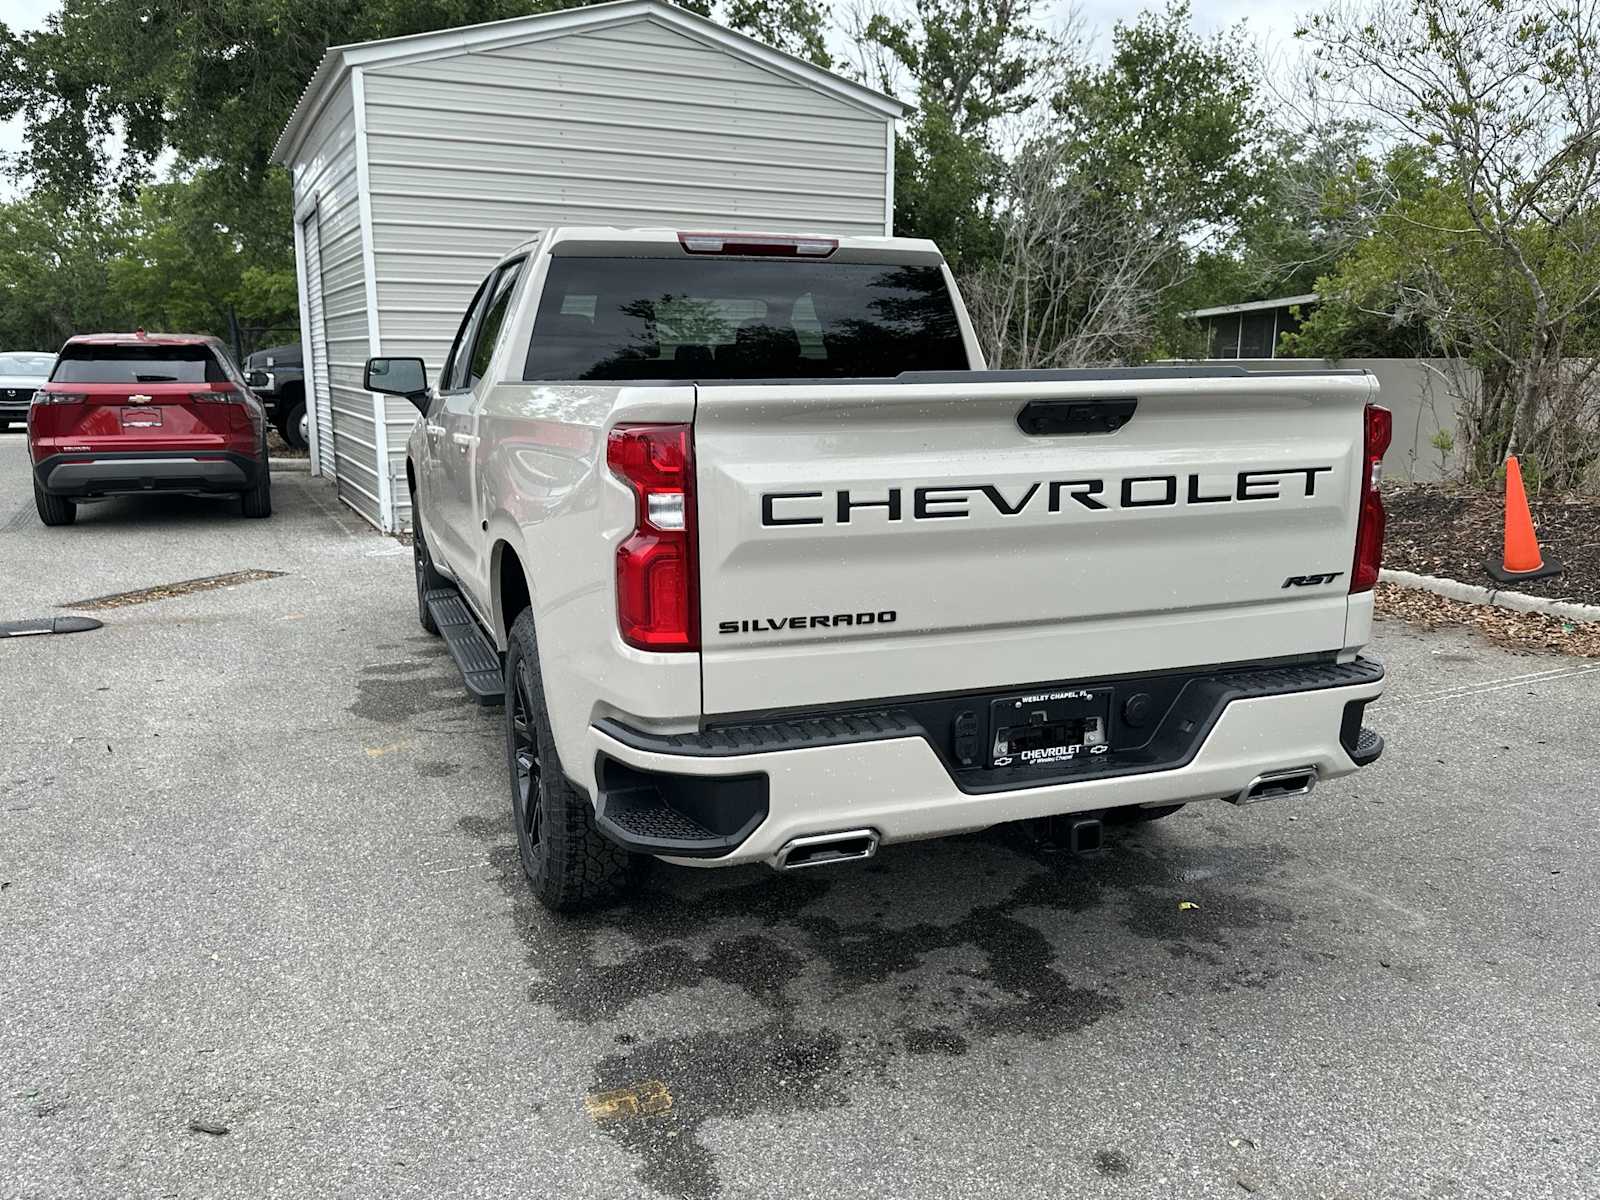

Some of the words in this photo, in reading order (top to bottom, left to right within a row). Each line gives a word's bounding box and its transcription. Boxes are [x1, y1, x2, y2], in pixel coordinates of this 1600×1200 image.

[761, 467, 1332, 526] CHEVROLET
[1282, 571, 1344, 589] RST
[718, 610, 897, 634] SILVERADO
[1022, 695, 1049, 703] WESLEY
[1021, 744, 1081, 760] CHEVROLET
